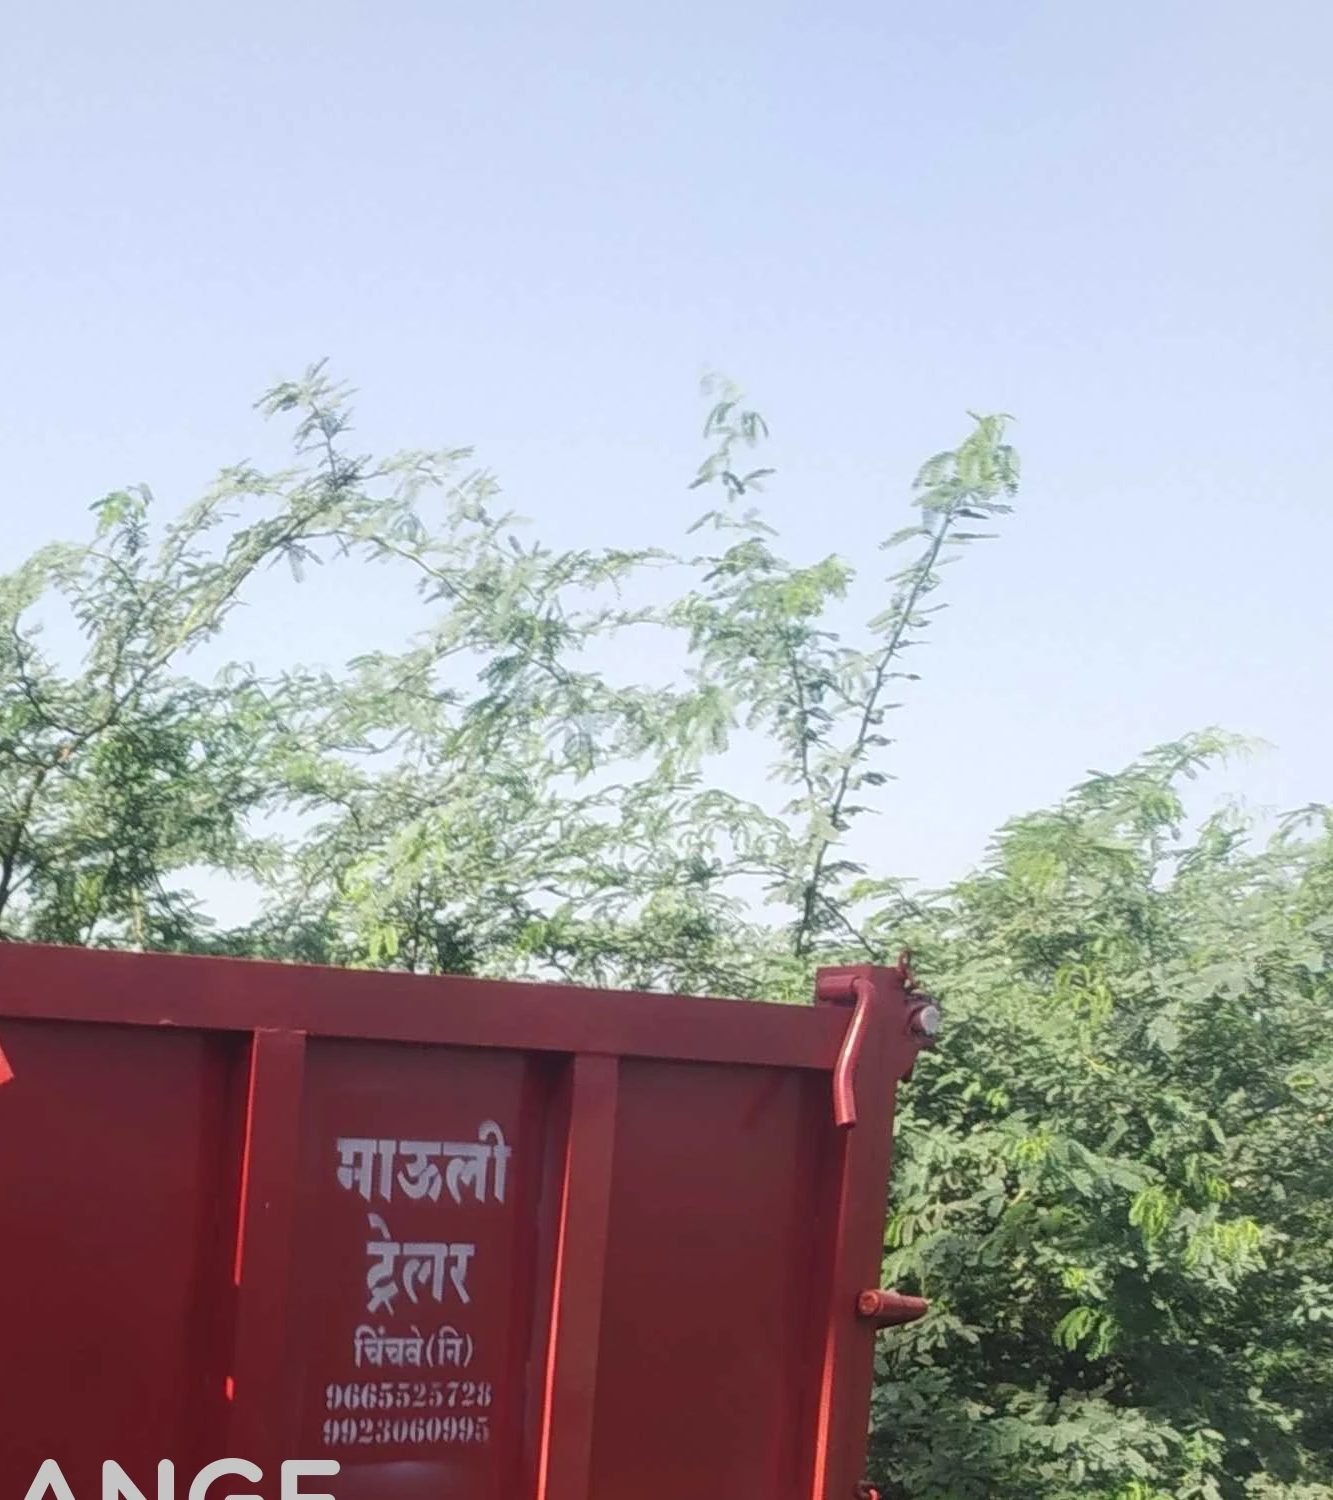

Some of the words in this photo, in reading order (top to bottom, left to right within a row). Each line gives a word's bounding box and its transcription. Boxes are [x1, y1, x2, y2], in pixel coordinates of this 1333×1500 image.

[336, 1120, 512, 1204] माऊली
[366, 1213, 475, 1315] ट्रेलर
[325, 1381, 493, 1410] 9665525728
[323, 1416, 490, 1446] 9923060995
